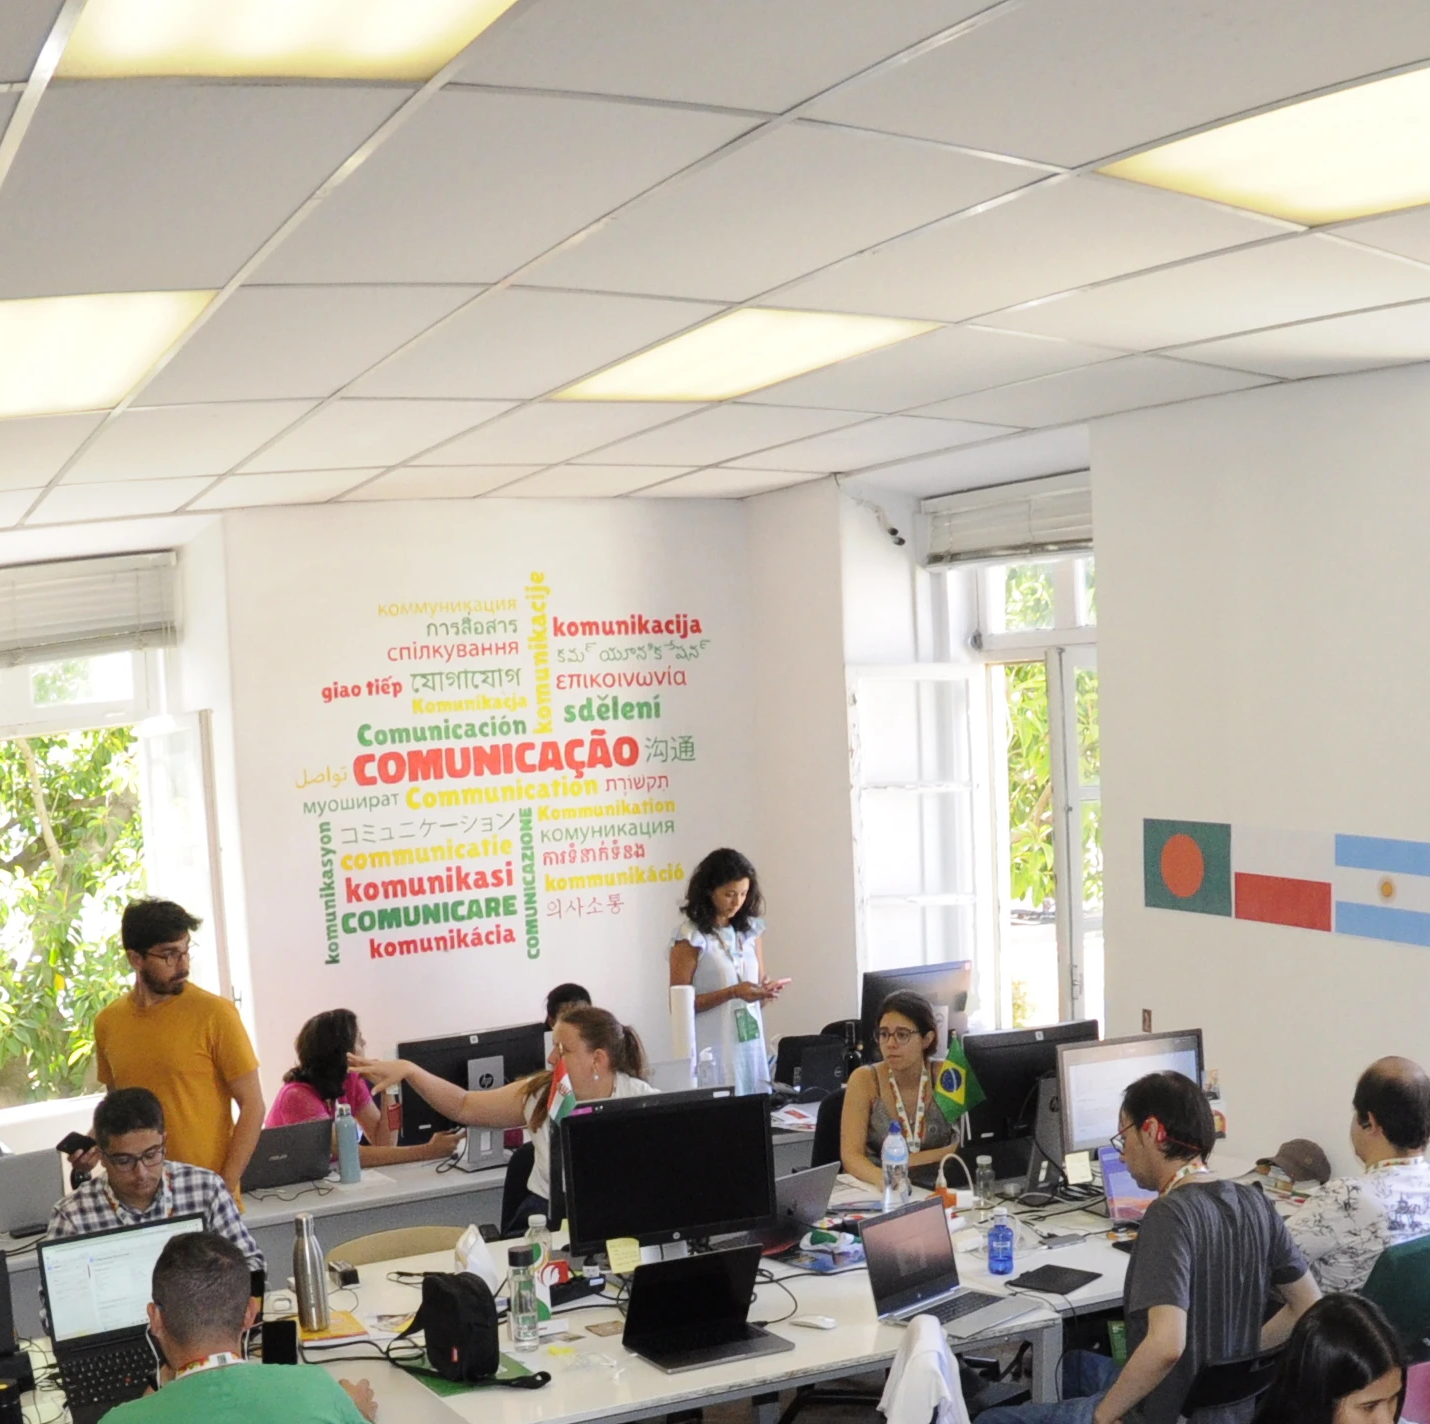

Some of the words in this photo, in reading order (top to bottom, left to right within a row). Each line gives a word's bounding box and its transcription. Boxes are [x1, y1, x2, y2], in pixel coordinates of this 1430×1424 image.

[377, 598, 517, 618] коммуникация
[552, 614, 702, 639] komunikacija
[387, 641, 519, 664] спілкування
[525, 571, 553, 735] komunikacije
[321, 682, 362, 704] giao
[366, 675, 403, 698] tiếp
[410, 668, 522, 693] যোগাযোগ
[556, 665, 687, 690] επικοινωνία
[411, 693, 528, 715] Komunikacja
[564, 694, 661, 723] sdělení
[357, 715, 527, 747] Comunicación
[353, 729, 640, 787] COMUNICAÇÃO
[644, 735, 697, 763] 沟通
[295, 765, 348, 789] تواصل
[302, 792, 400, 818] муошират
[405, 776, 598, 811] Communication
[537, 798, 676, 822] Kommunikation
[341, 813, 515, 844] コミュニケーション
[540, 820, 675, 844] комуникация
[340, 834, 513, 872] communicatie
[345, 861, 514, 904] komunikasi
[519, 807, 540, 960] COMUNICAZIONE
[544, 861, 685, 892] kommunikáció
[318, 821, 340, 964] komunikasyon
[545, 893, 625, 919] 의사소통
[341, 895, 518, 935] COMUNICARE
[369, 924, 516, 960] komunikácia
